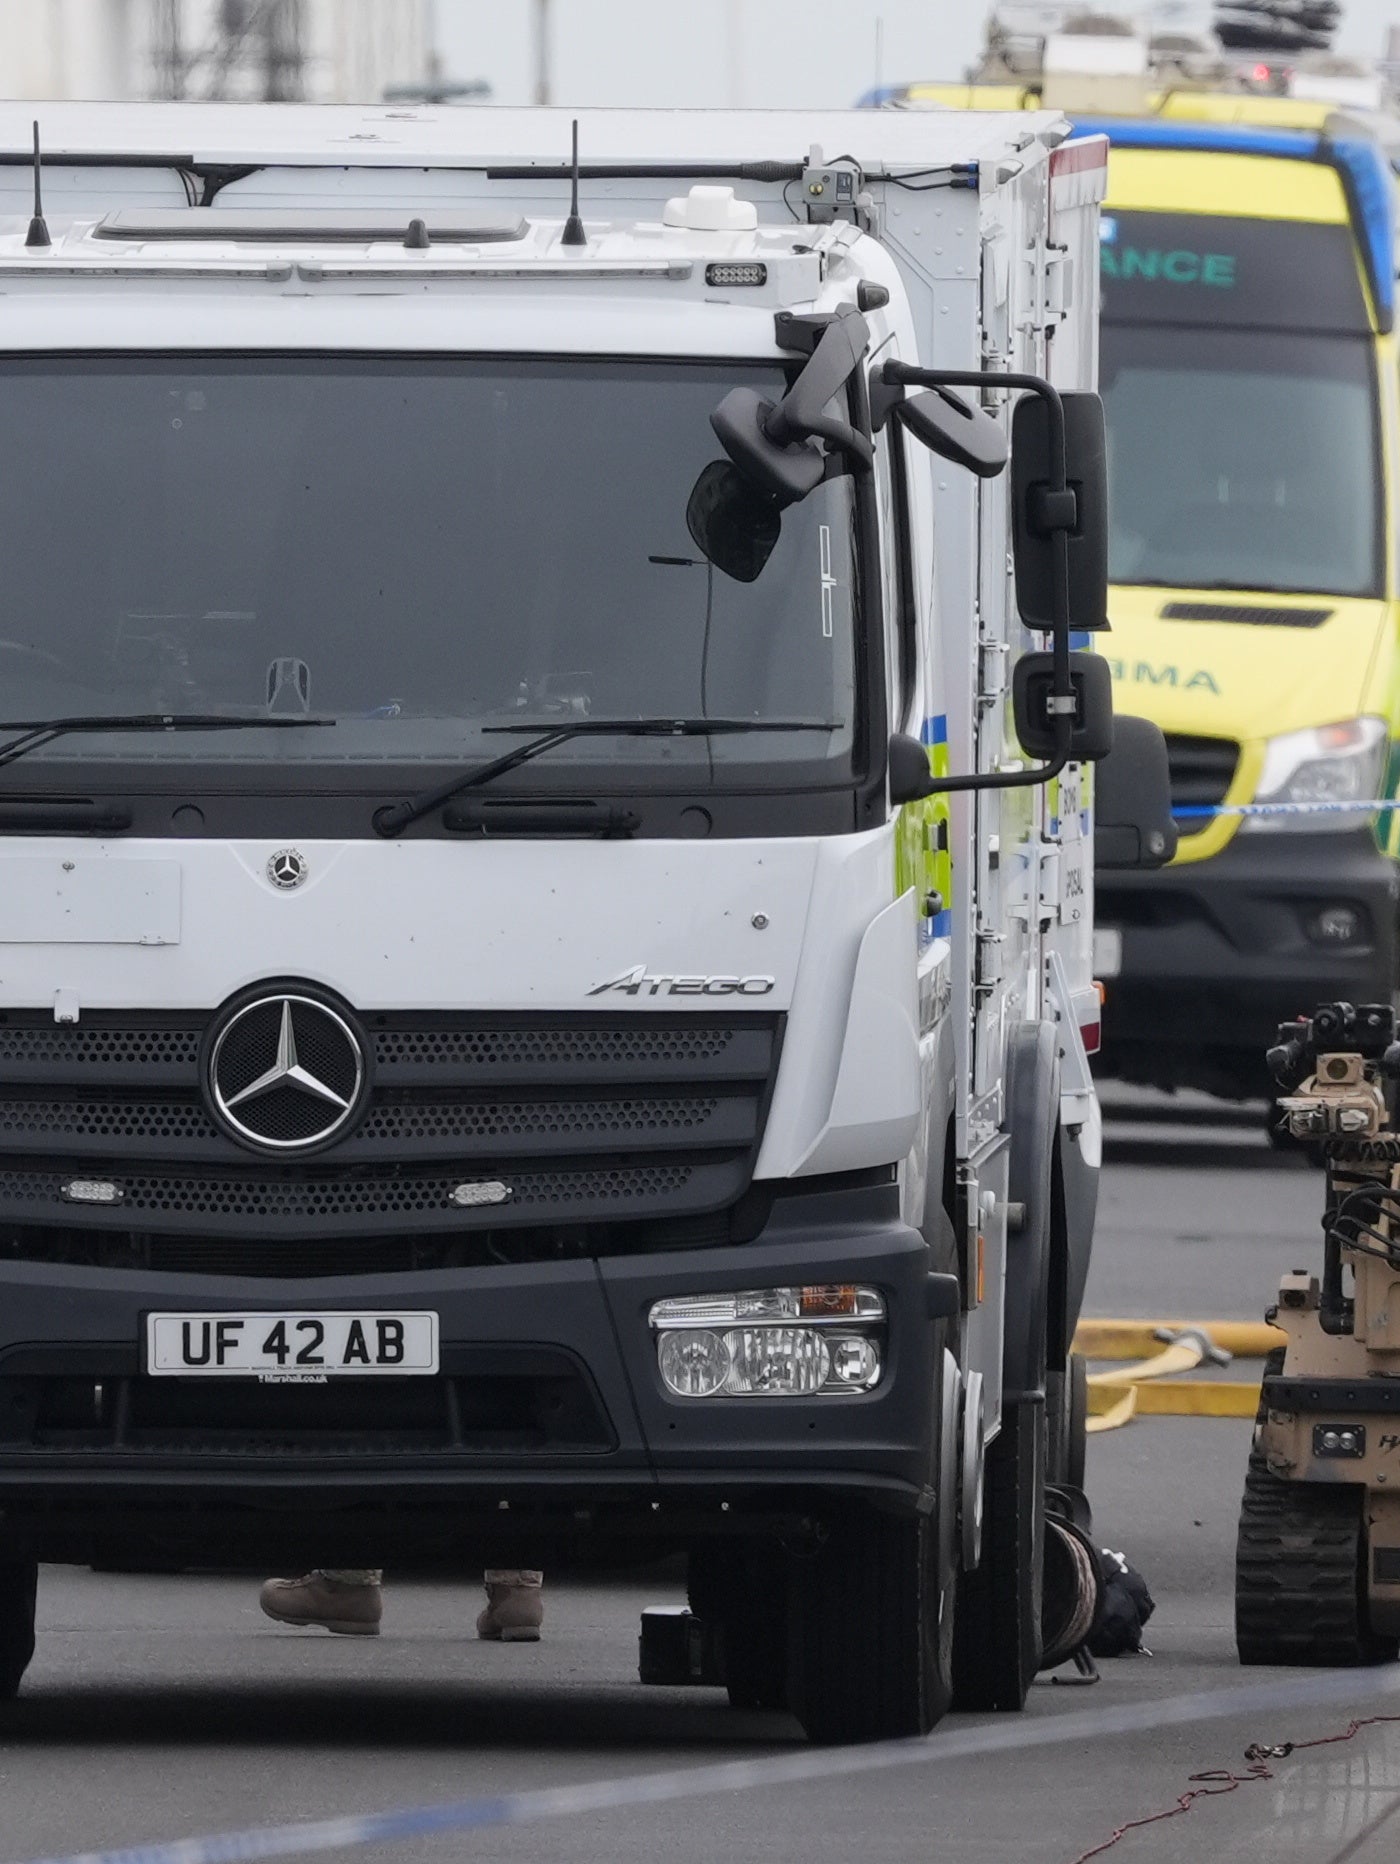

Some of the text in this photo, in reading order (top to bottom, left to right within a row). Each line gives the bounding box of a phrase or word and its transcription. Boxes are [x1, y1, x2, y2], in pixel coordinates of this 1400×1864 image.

[182, 1319, 404, 1366] UF 42 AB
